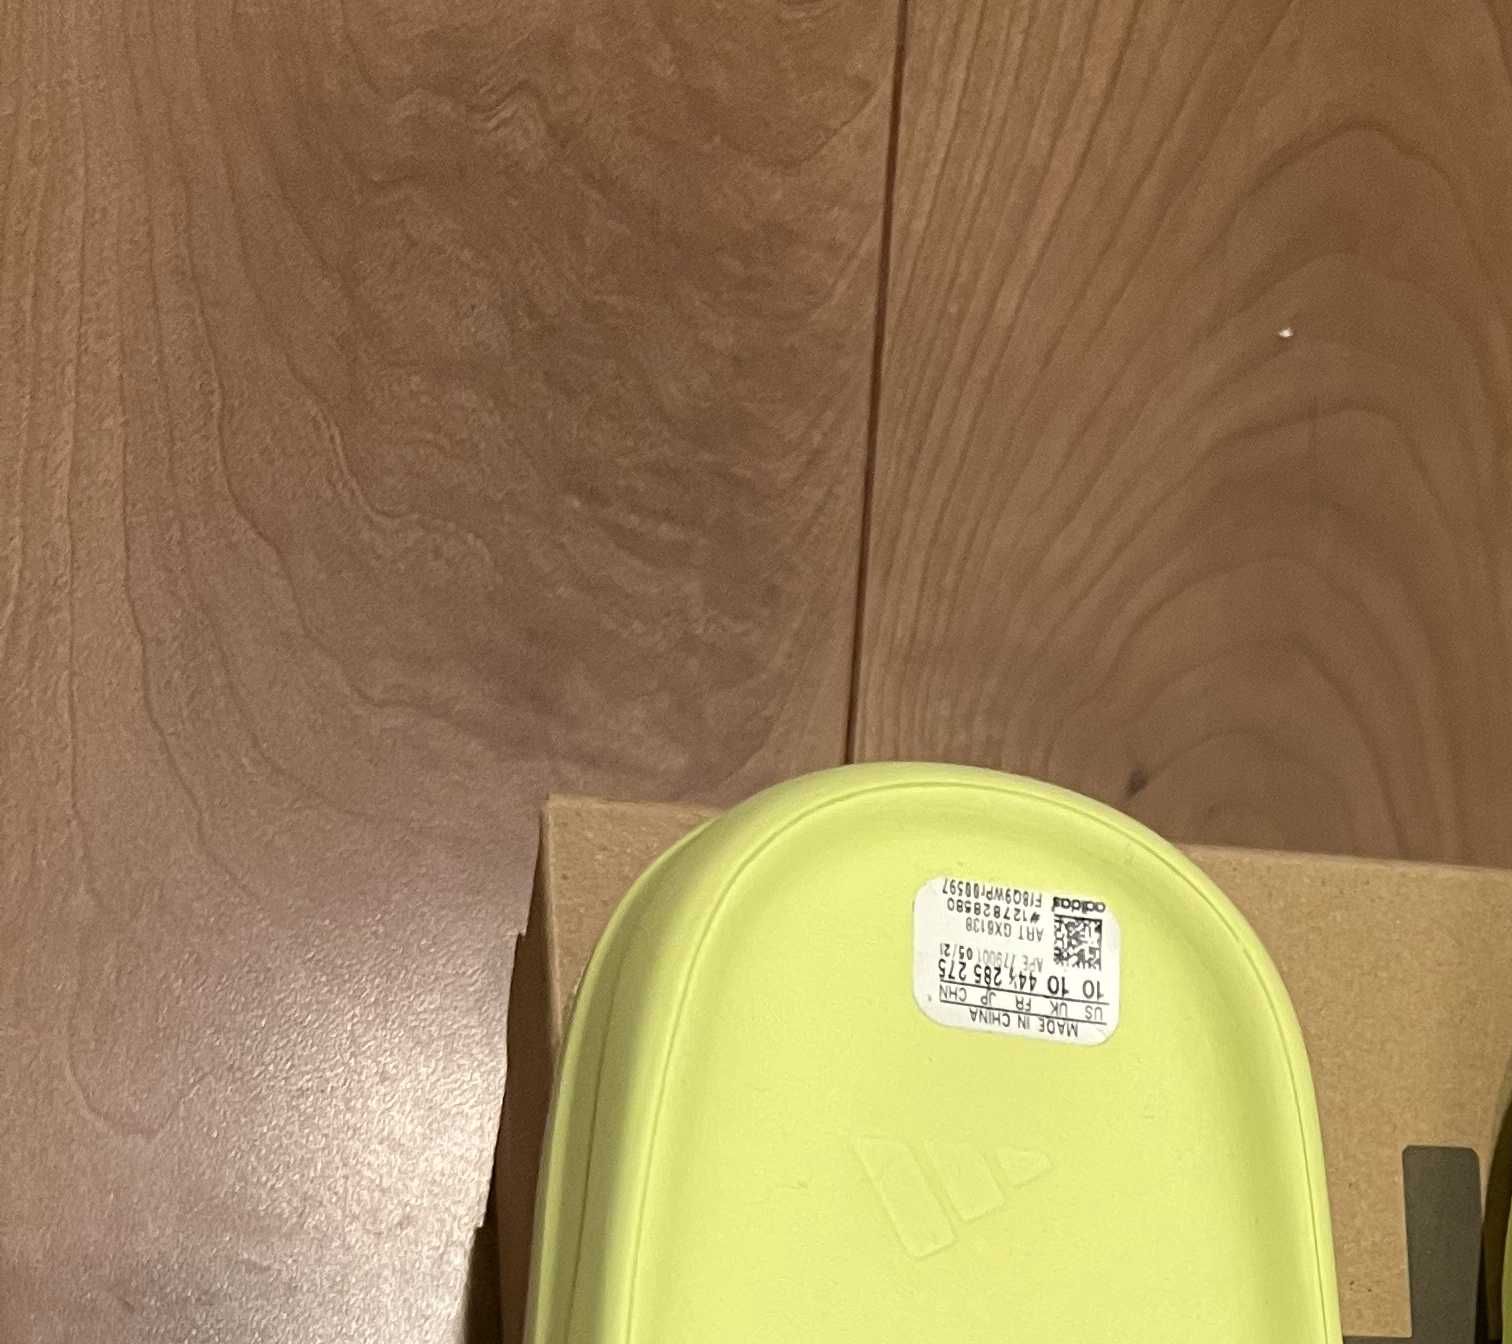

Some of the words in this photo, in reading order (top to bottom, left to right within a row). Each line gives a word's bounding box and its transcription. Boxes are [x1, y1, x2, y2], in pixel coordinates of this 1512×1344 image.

[1052, 897, 1105, 913] adidas
[1018, 927, 1043, 942] ART
[938, 959, 966, 981] 275
[974, 964, 1001, 986] 285
[939, 985, 967, 1002] CHN
[1048, 976, 1069, 997] 10
[1083, 980, 1103, 999] 10
[981, 990, 996, 1005] JP
[1015, 997, 1031, 1012] FR
[1050, 1001, 1067, 1017] UK
[1085, 1006, 1103, 1020] US
[969, 1009, 1010, 1027] CHINA
[1018, 1016, 1030, 1029] IN
[1039, 1017, 1078, 1037] MADE
